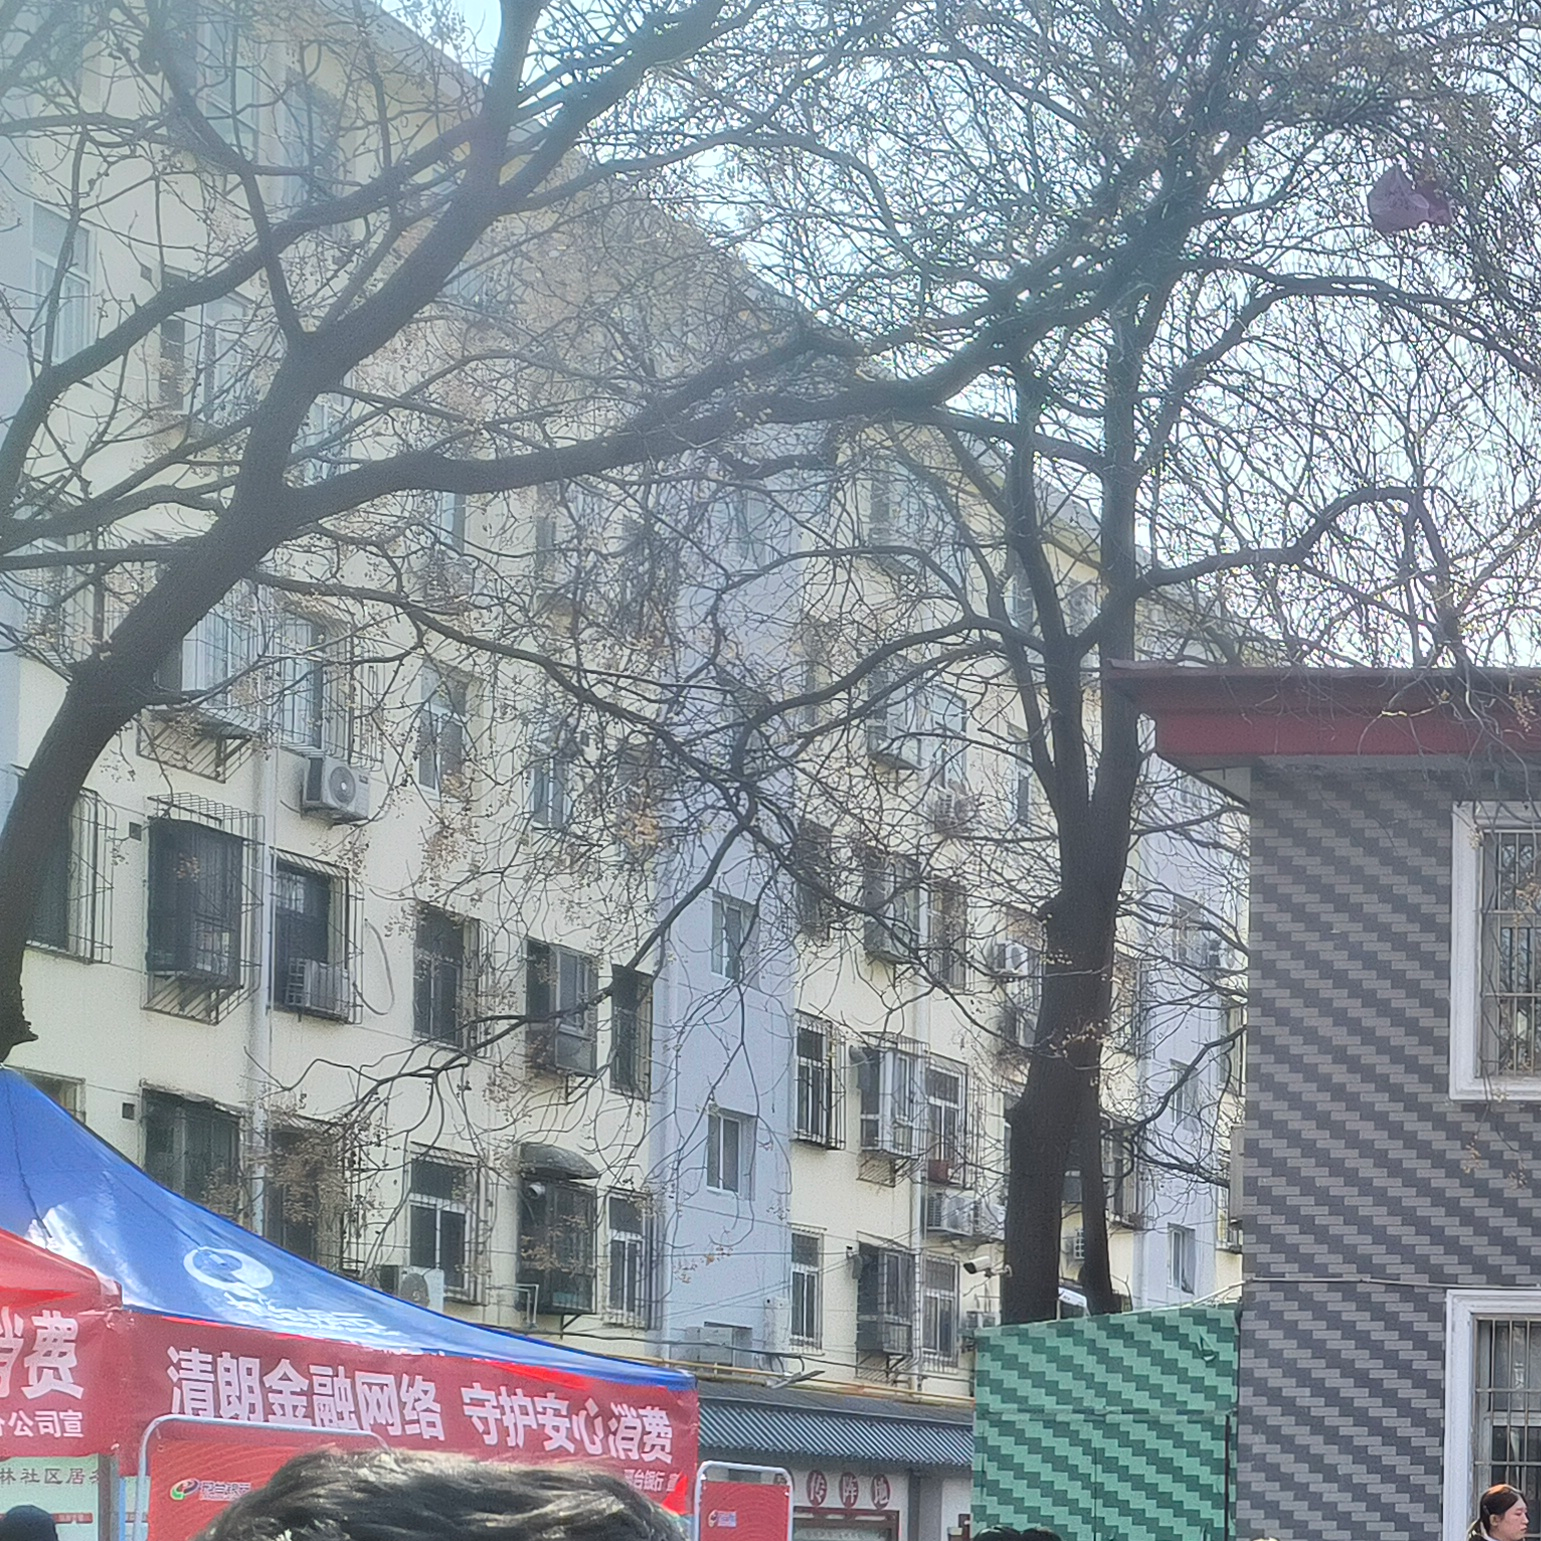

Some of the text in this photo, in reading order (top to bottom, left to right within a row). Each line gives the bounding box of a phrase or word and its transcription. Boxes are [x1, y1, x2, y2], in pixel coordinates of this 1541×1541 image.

[0, 1410, 84, 1438] 公司宣
[167, 1345, 673, 1464] 清朗金融网络 守护安心消费
